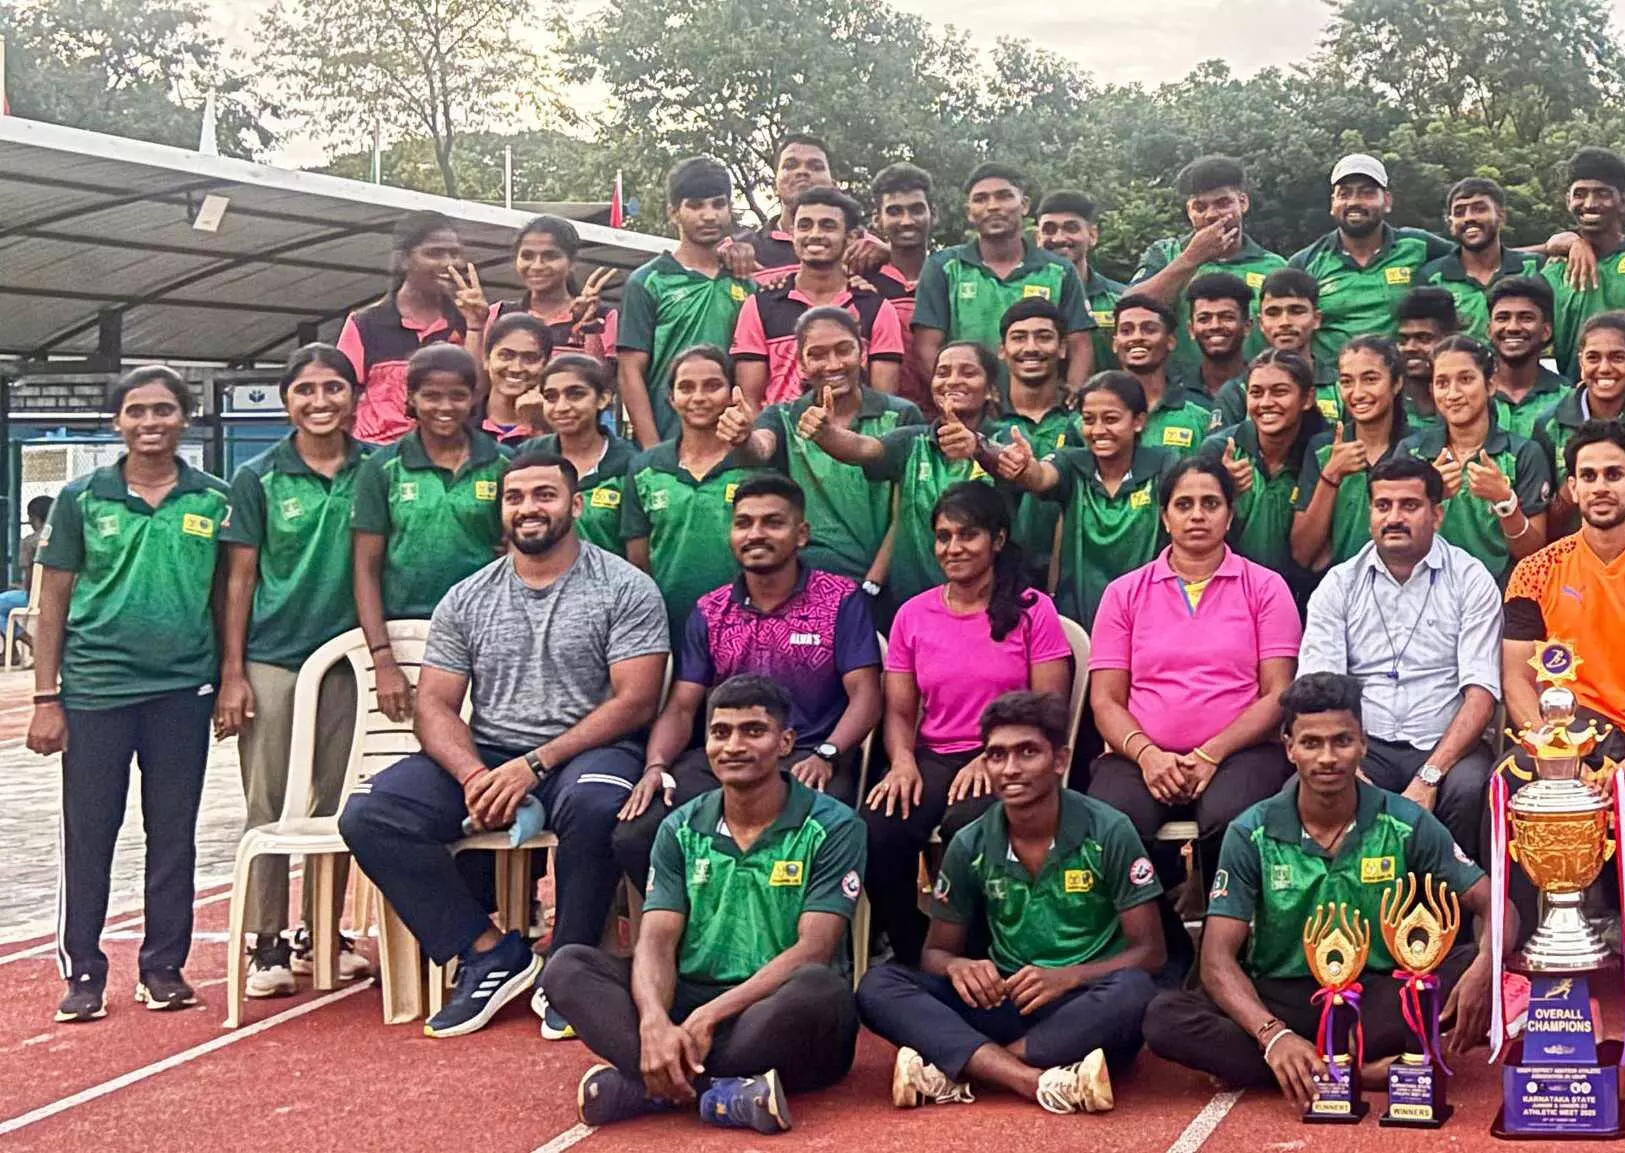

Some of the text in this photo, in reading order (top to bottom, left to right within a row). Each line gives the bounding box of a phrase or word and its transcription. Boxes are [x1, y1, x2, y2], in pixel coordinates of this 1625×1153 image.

[1535, 1008, 1584, 1020] OVERALL
[1527, 1021, 1592, 1033] CHAMPIONS
[1522, 1095, 1597, 1104] KARNATAKA STATE
[1394, 1107, 1430, 1117] WINNERS
[1522, 1108, 1558, 1116] ATHLETIC
